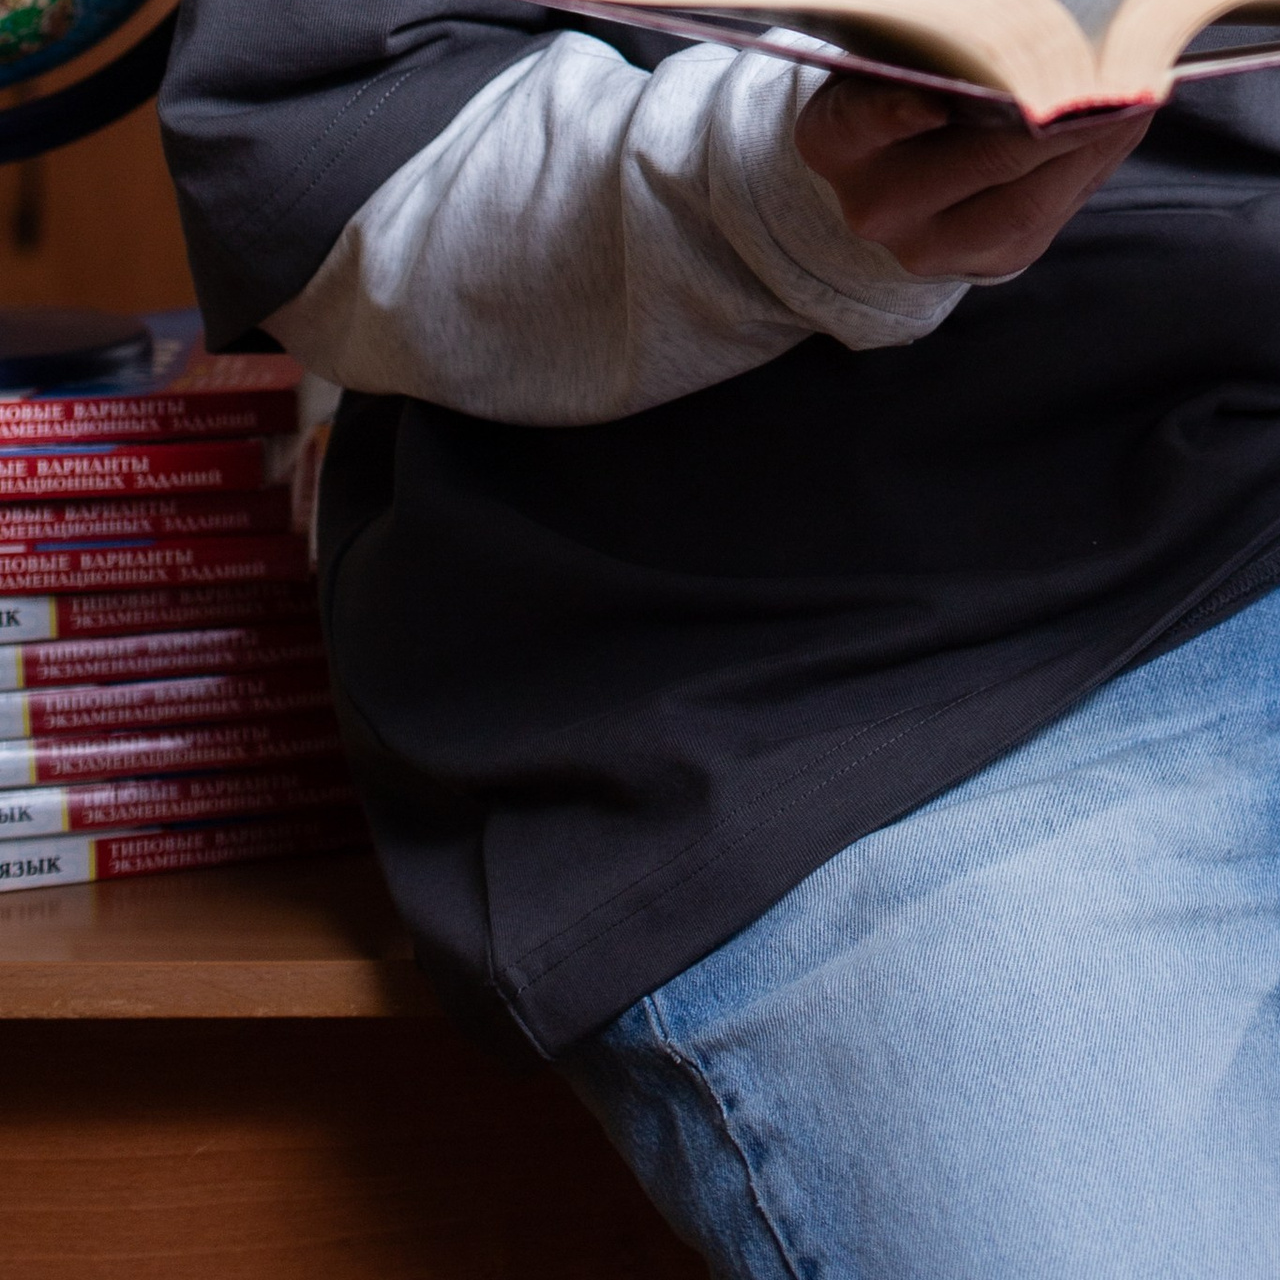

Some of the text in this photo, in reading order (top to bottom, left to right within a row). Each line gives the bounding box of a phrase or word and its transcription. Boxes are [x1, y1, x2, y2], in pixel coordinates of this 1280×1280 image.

[74, 399, 185, 419] ВАРИАНТЫ
[37, 456, 151, 476] ВАРИАНТЫ
[134, 469, 222, 490] ЗАДАНИЙ
[65, 501, 177, 522] ВАРИАНТЫ
[80, 549, 194, 570] ВАРИАНТЫ
[178, 561, 266, 581] ЗАДАНИЙ
[0, 857, 61, 879] ЯЗЫК
